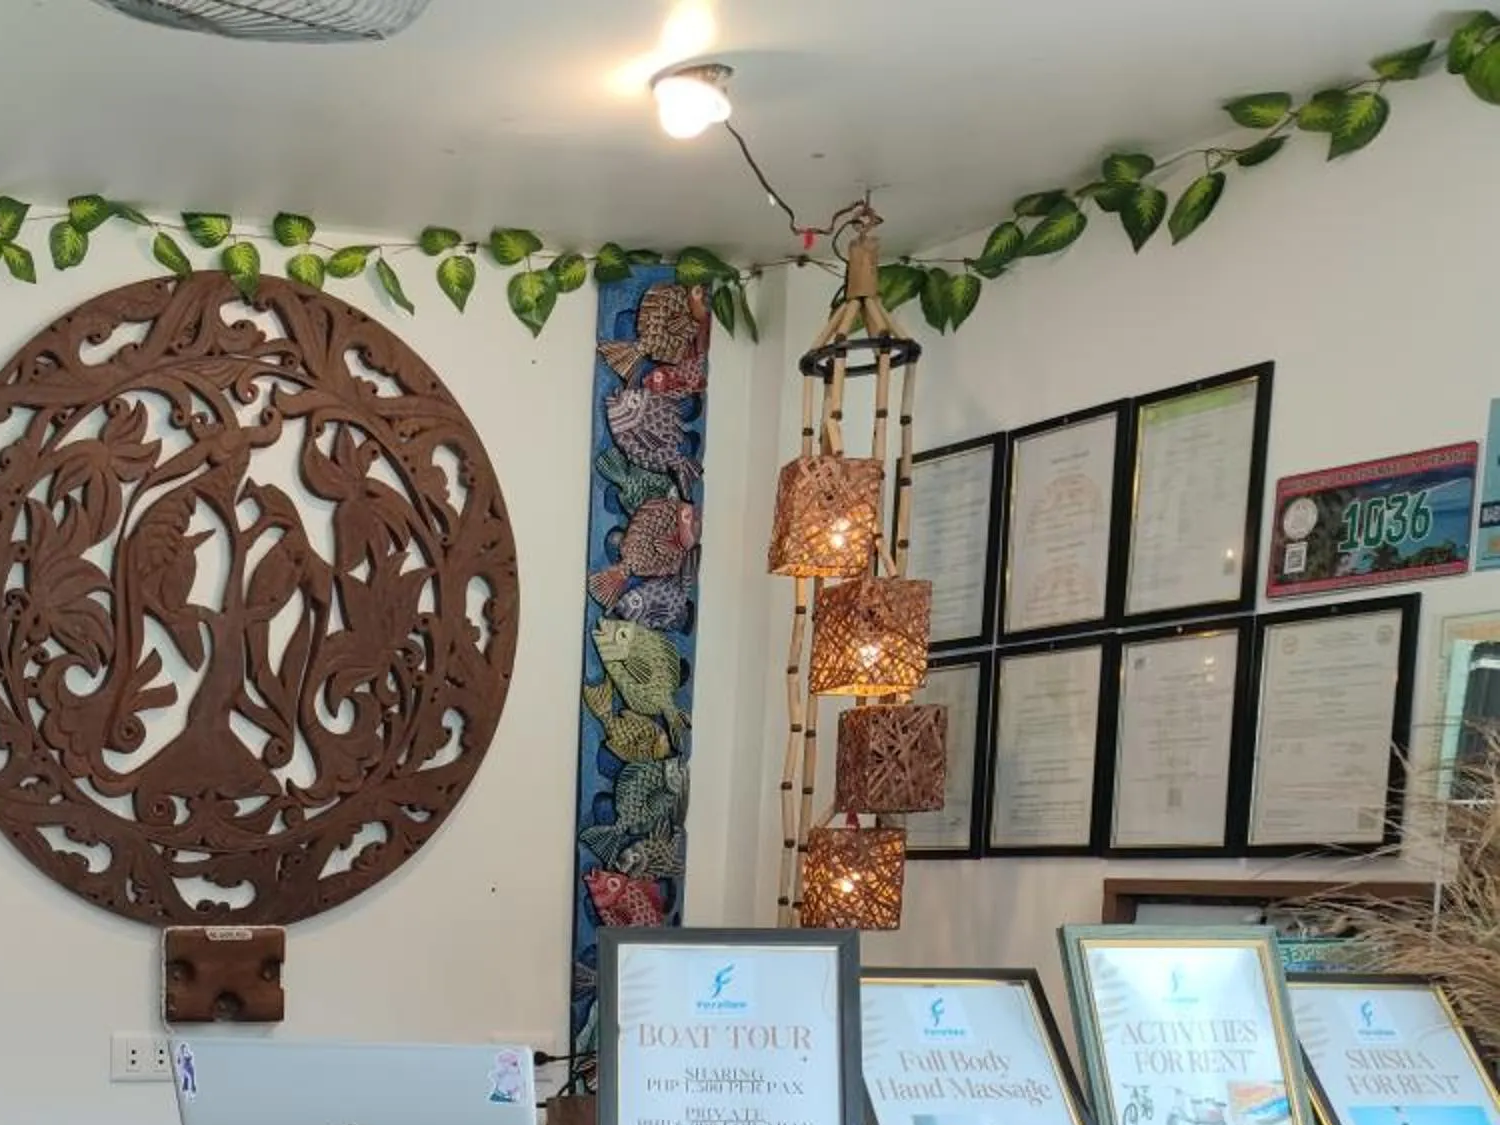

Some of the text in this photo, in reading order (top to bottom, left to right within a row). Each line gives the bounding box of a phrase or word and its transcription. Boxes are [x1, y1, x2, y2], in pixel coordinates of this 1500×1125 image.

[1338, 491, 1433, 552] 1036
[638, 1023, 813, 1050] BOAT TOUR
[898, 1050, 1012, 1076] Full Body
[1134, 1049, 1258, 1075] FOR RENT
[876, 1076, 1053, 1107] Hand Massage
[1347, 1074, 1459, 1095] FOR RENT
